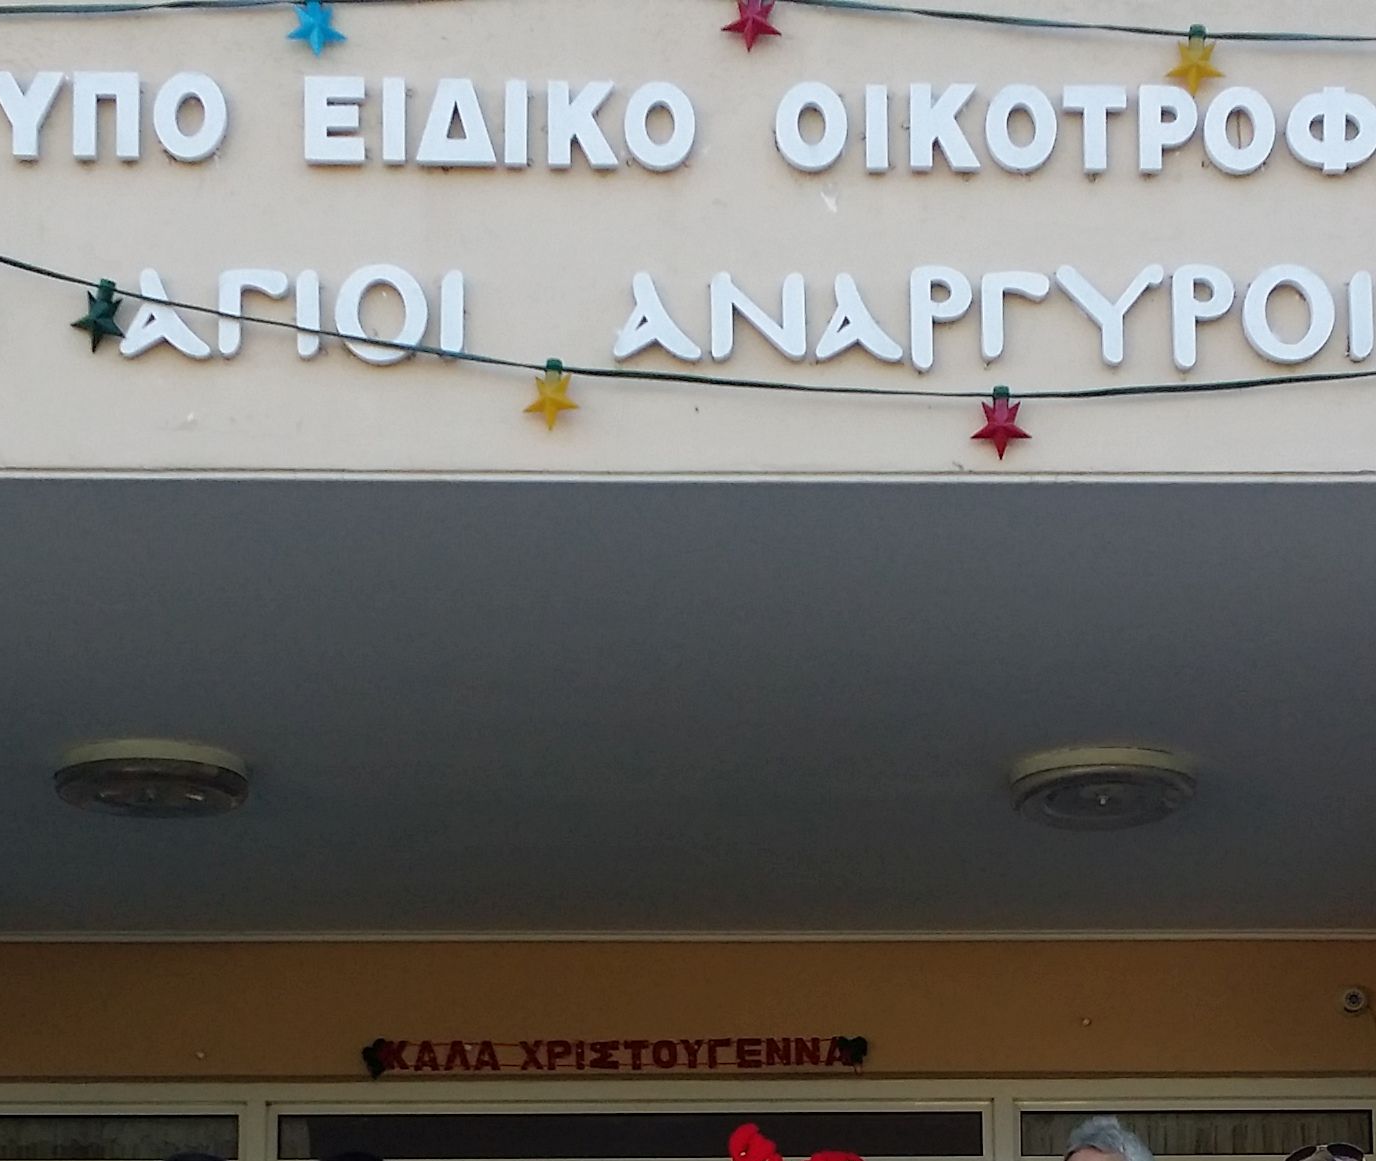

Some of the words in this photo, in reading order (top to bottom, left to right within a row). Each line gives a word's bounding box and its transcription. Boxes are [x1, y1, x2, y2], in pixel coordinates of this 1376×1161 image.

[303, 76, 697, 172] ΕΙΔΙΚΟ
[119, 264, 466, 366] ΑΓΙΟΙ
[383, 1039, 501, 1072] ΚΑΛΑ
[521, 1036, 853, 1071] ΧΡΙΣΤΟΥΓΕΝΝΑ
